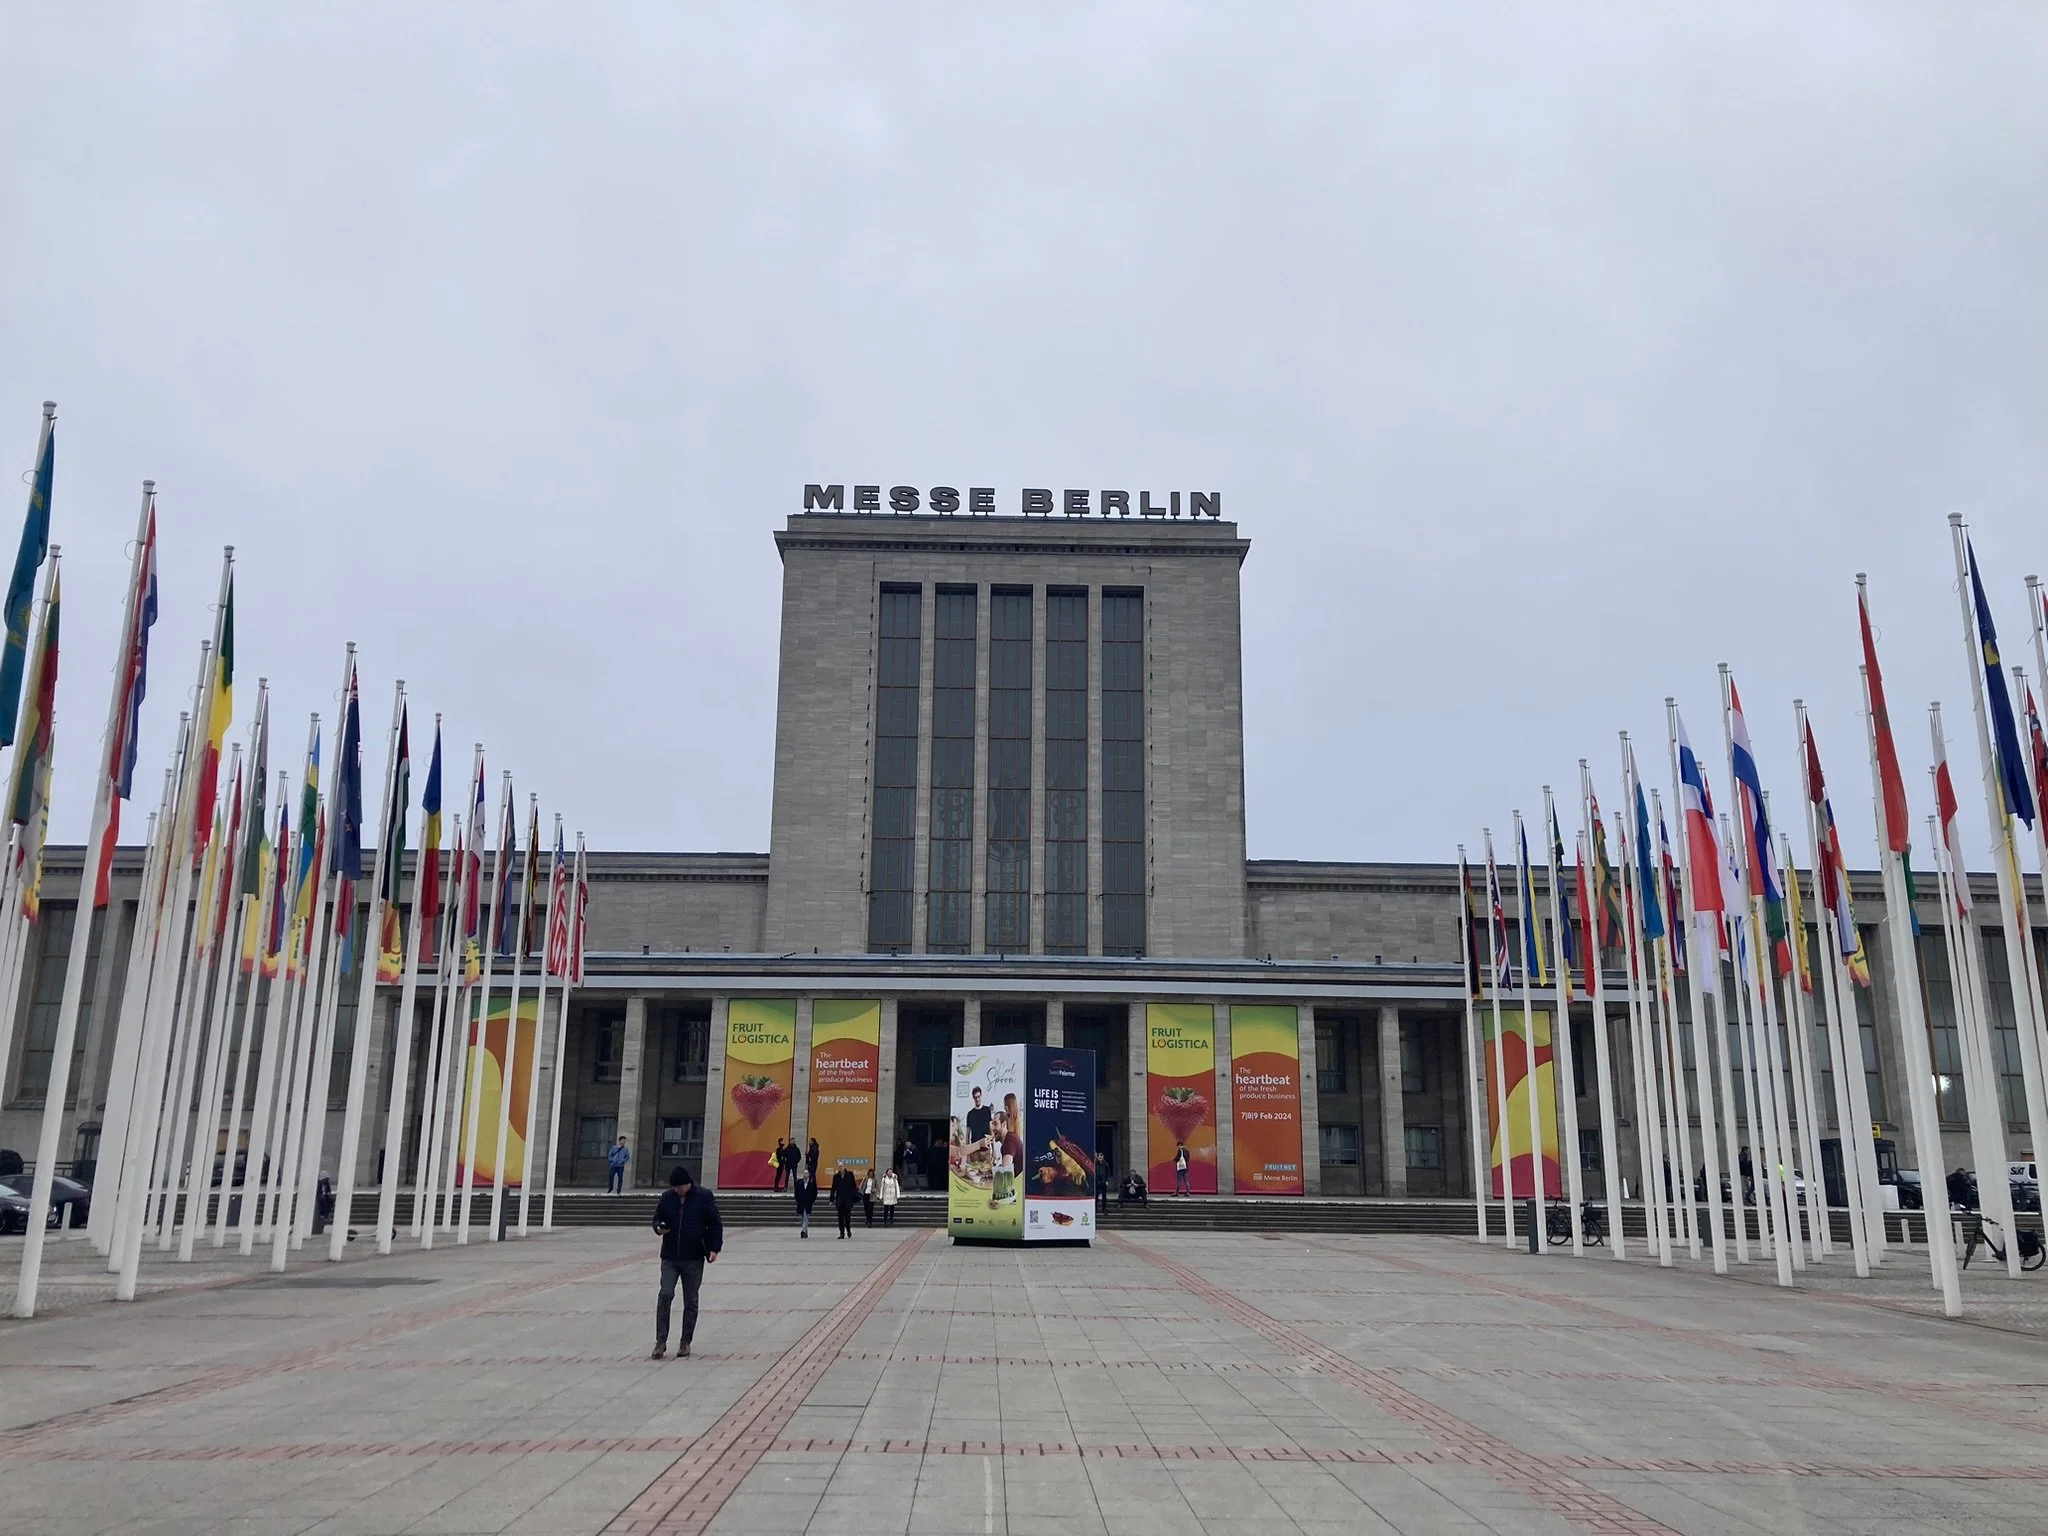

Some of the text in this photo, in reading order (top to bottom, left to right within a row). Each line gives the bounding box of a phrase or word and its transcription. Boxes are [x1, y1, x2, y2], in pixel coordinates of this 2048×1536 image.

[803, 484, 1221, 517] MESSE BERLIN
[732, 1023, 764, 1033] FRUIT
[1151, 1028, 1182, 1037] FRUIT
[732, 1034, 789, 1044] LOGISTICA
[1151, 1039, 1208, 1049] LOGISTICA
[816, 1058, 869, 1069] heartbeat
[1235, 1074, 1290, 1085] heartbeat
[1034, 1088, 1059, 1098] LIFE IS
[836, 1095, 849, 1103] Feb
[850, 1095, 869, 1103] 2024
[1034, 1098, 1059, 1109] SWEET
[1260, 1112, 1273, 1120] Feb
[1273, 1112, 1292, 1120] 2024
